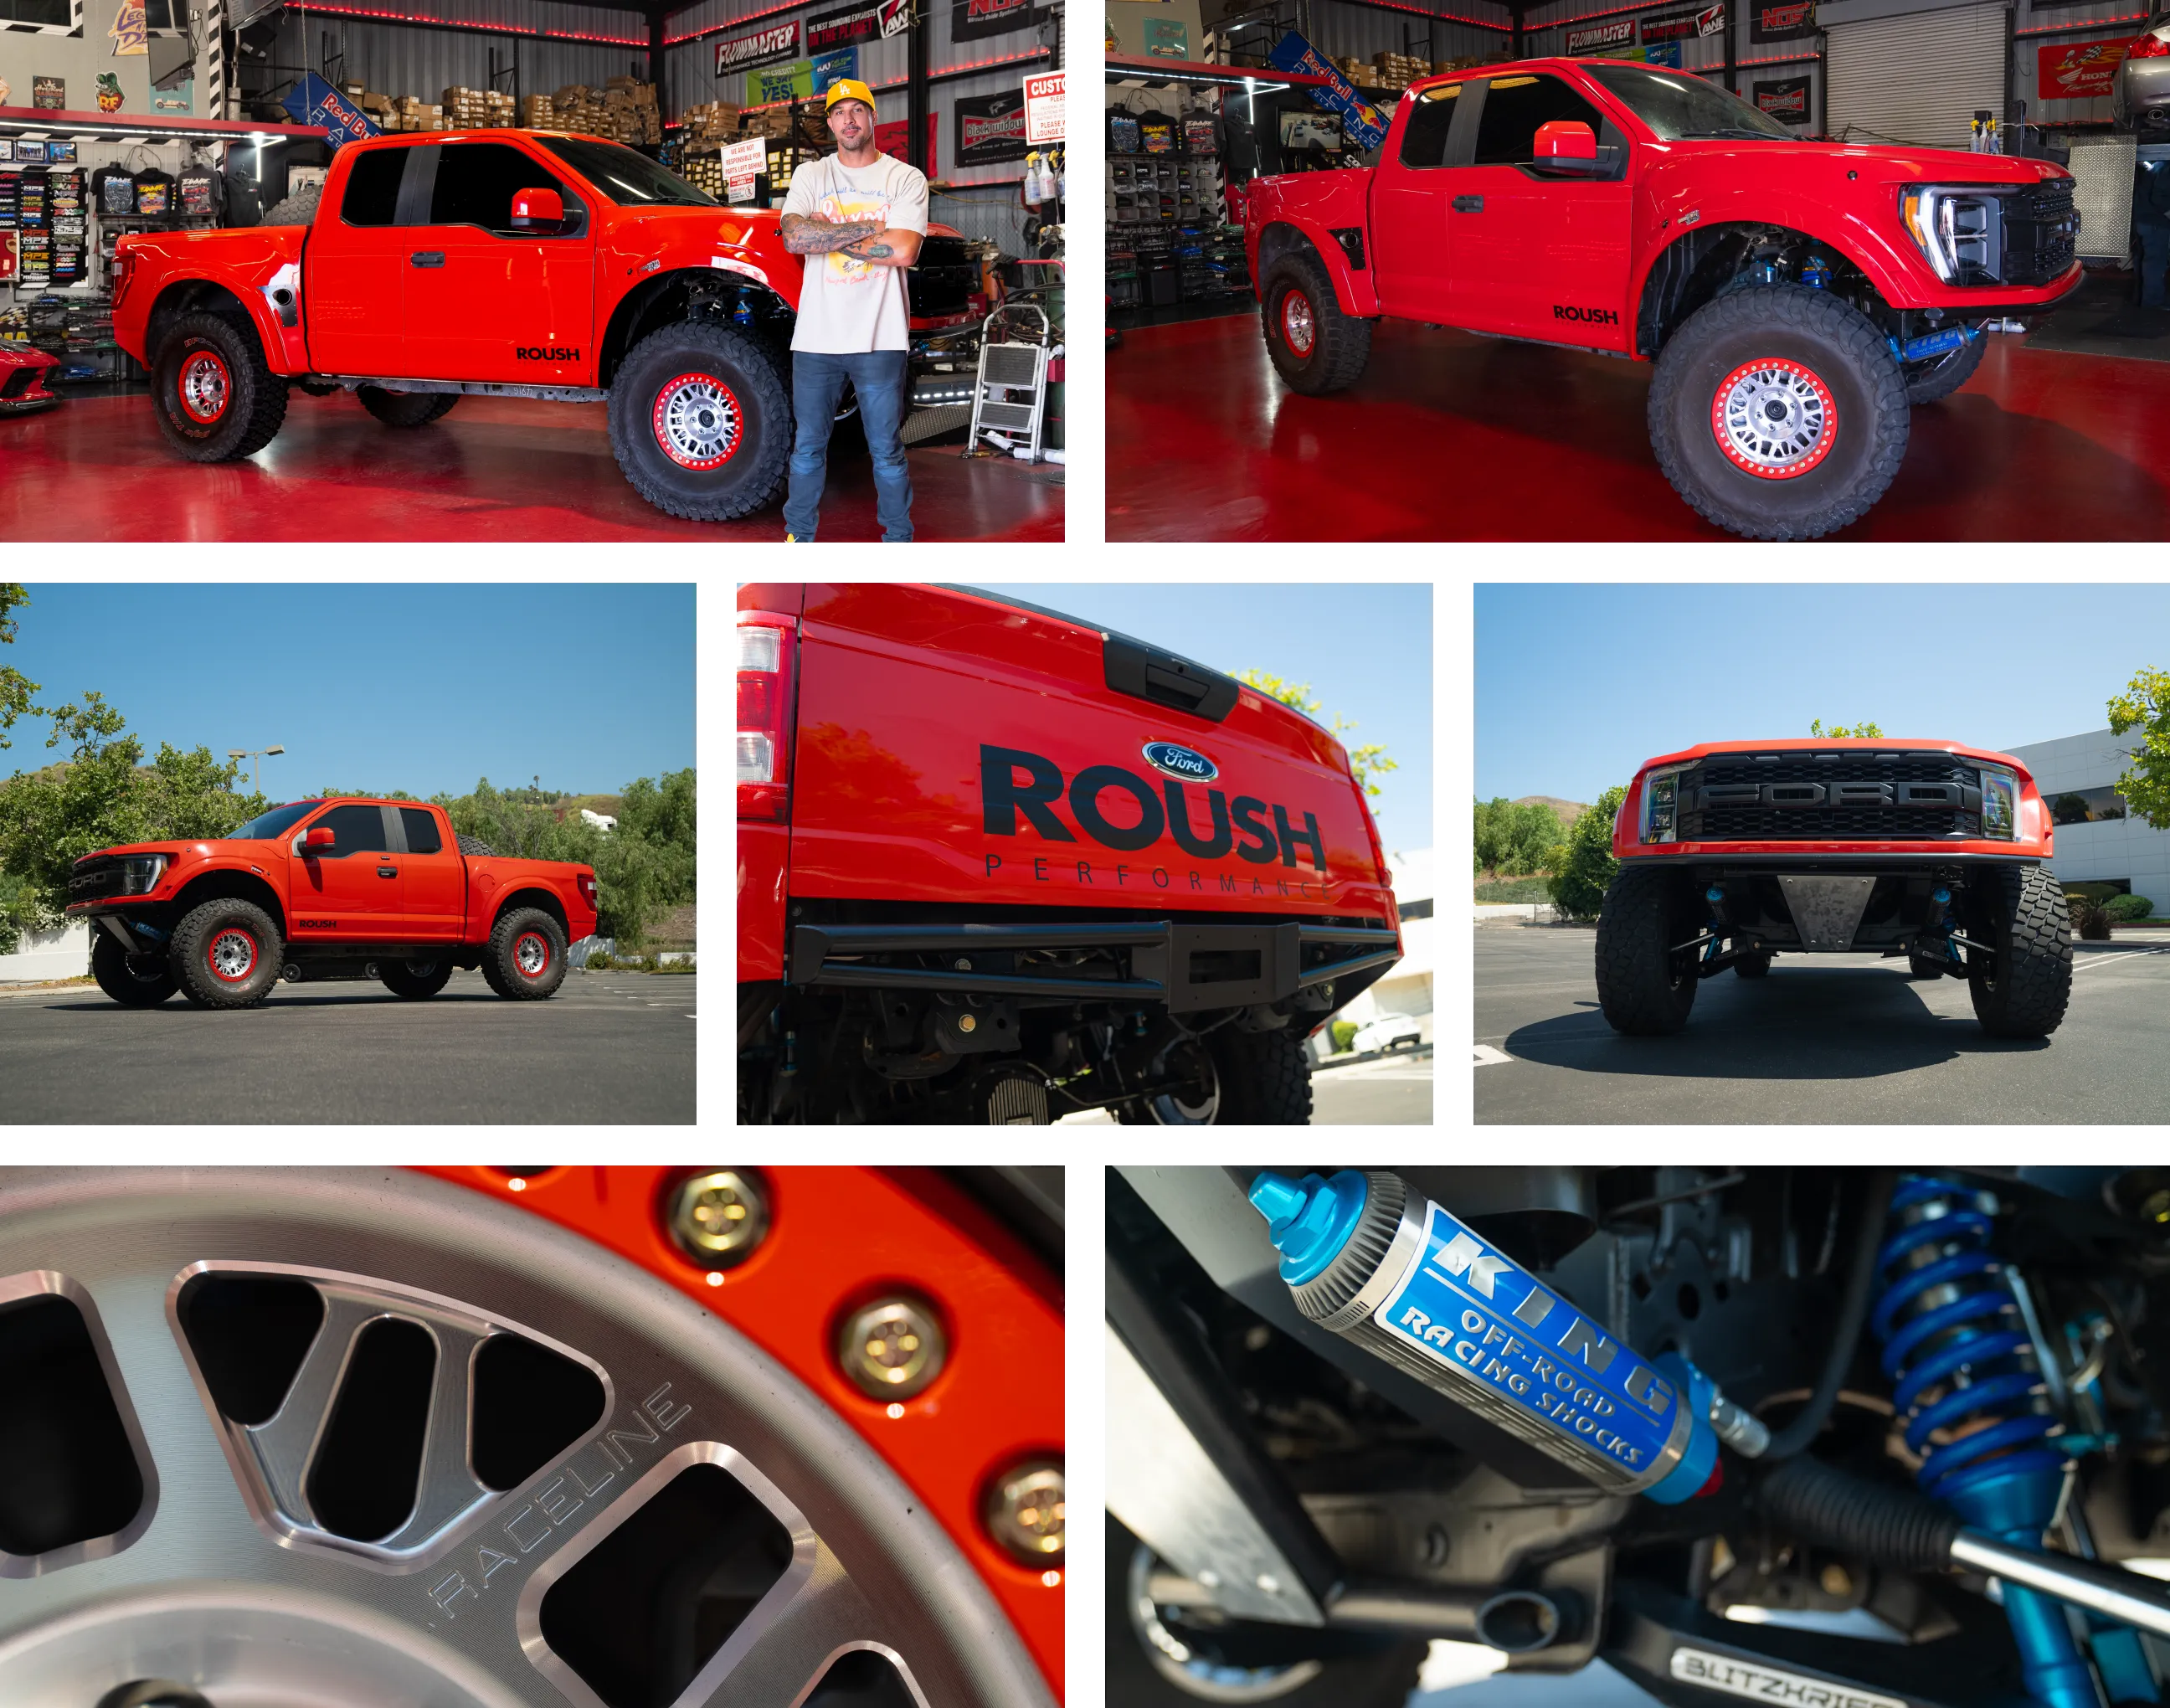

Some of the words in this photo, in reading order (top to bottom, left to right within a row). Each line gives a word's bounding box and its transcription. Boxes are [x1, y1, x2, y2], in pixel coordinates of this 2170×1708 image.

[808, 26, 816, 34] THE
[816, 22, 828, 32] BEST
[828, 16, 851, 29] SOUNDING
[838, 17, 876, 40] PLANET
[717, 24, 794, 75] FLOWMASTER
[1567, 22, 1631, 55] FLOWMASTER
[750, 56, 775, 65] TECHNOLOGY
[1300, 49, 1331, 78] Red
[1329, 71, 1354, 101] Bull
[761, 84, 794, 102] YES!
[839, 84, 851, 95] LA
[321, 92, 357, 126] Red
[1036, 128, 1059, 137] LOUNGE
[725, 155, 752, 166] RESPONSIBLE
[748, 162, 764, 170] BEHIND
[1553, 305, 1619, 325] ROUSH
[516, 347, 580, 361] ROUSH
[1165, 748, 1205, 774] Ford
[1697, 781, 1965, 809] FORD
[980, 743, 1326, 872] ROUSH
[68, 871, 106, 893] FORD
[985, 854, 1331, 900] PERFORMANCE
[299, 920, 337, 929] ROUSH
[1431, 1232, 1673, 1415] KING
[1461, 1309, 1617, 1418] OFF-ROAD
[1400, 1306, 1532, 1397] RACING
[1535, 1392, 1643, 1466] SHOCKS
[429, 1381, 691, 1619] RACELINE
